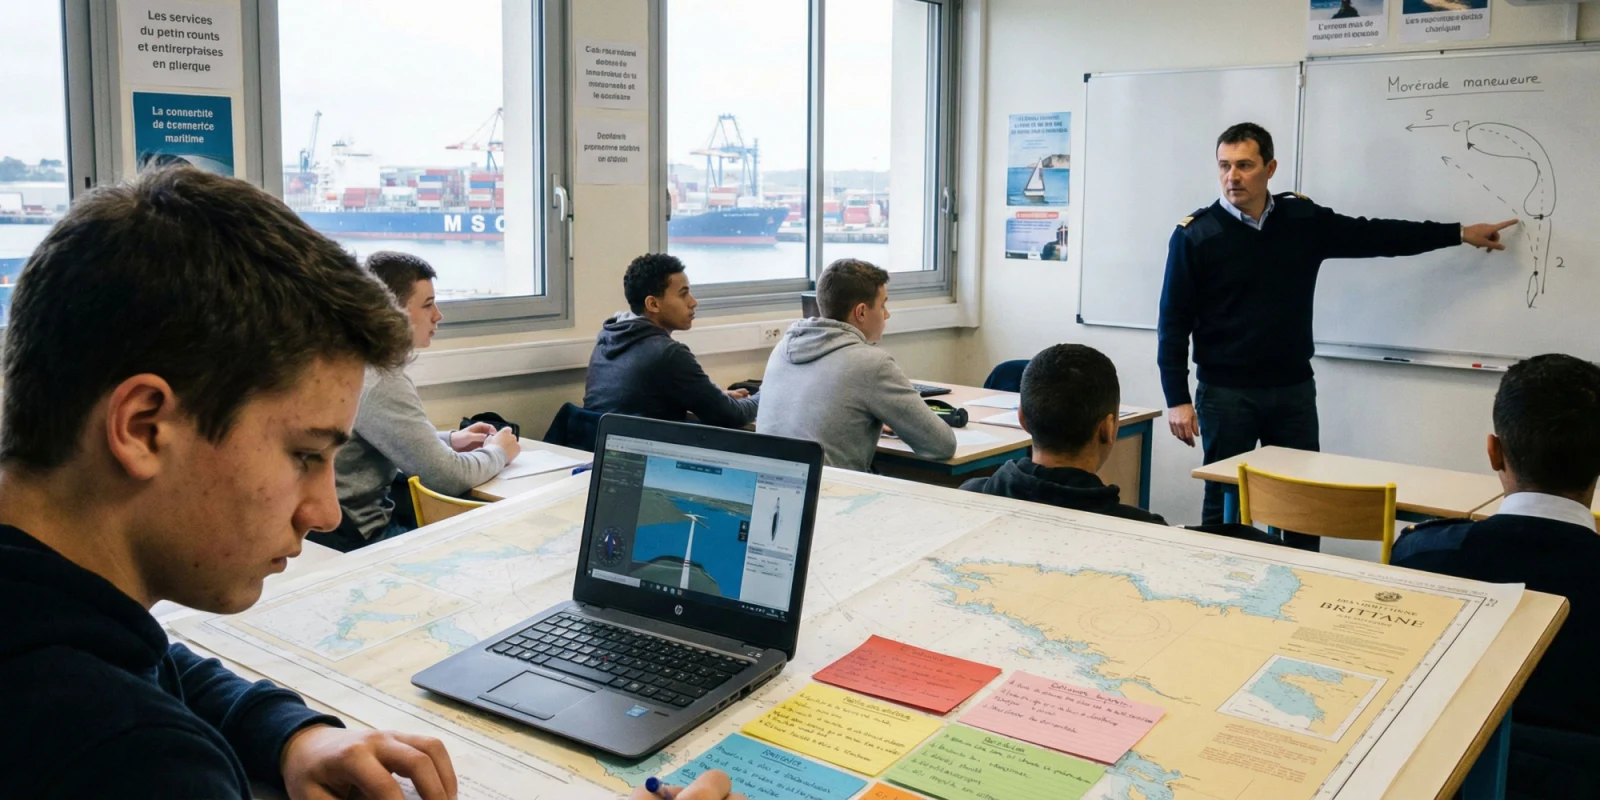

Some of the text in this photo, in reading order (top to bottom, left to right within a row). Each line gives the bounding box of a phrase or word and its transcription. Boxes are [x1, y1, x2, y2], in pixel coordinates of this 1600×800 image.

[148, 10, 213, 25] Les services
[140, 26, 154, 36] du
[157, 28, 185, 39] petin
[138, 42, 149, 52] et
[152, 60, 166, 69] en
[1387, 76, 1450, 93] Morérade
[152, 106, 164, 116] La
[152, 120, 164, 129] de
[165, 134, 204, 144] maritime
[1556, 256, 1566, 268] 2
[1319, 602, 1425, 628] BRITTANE
